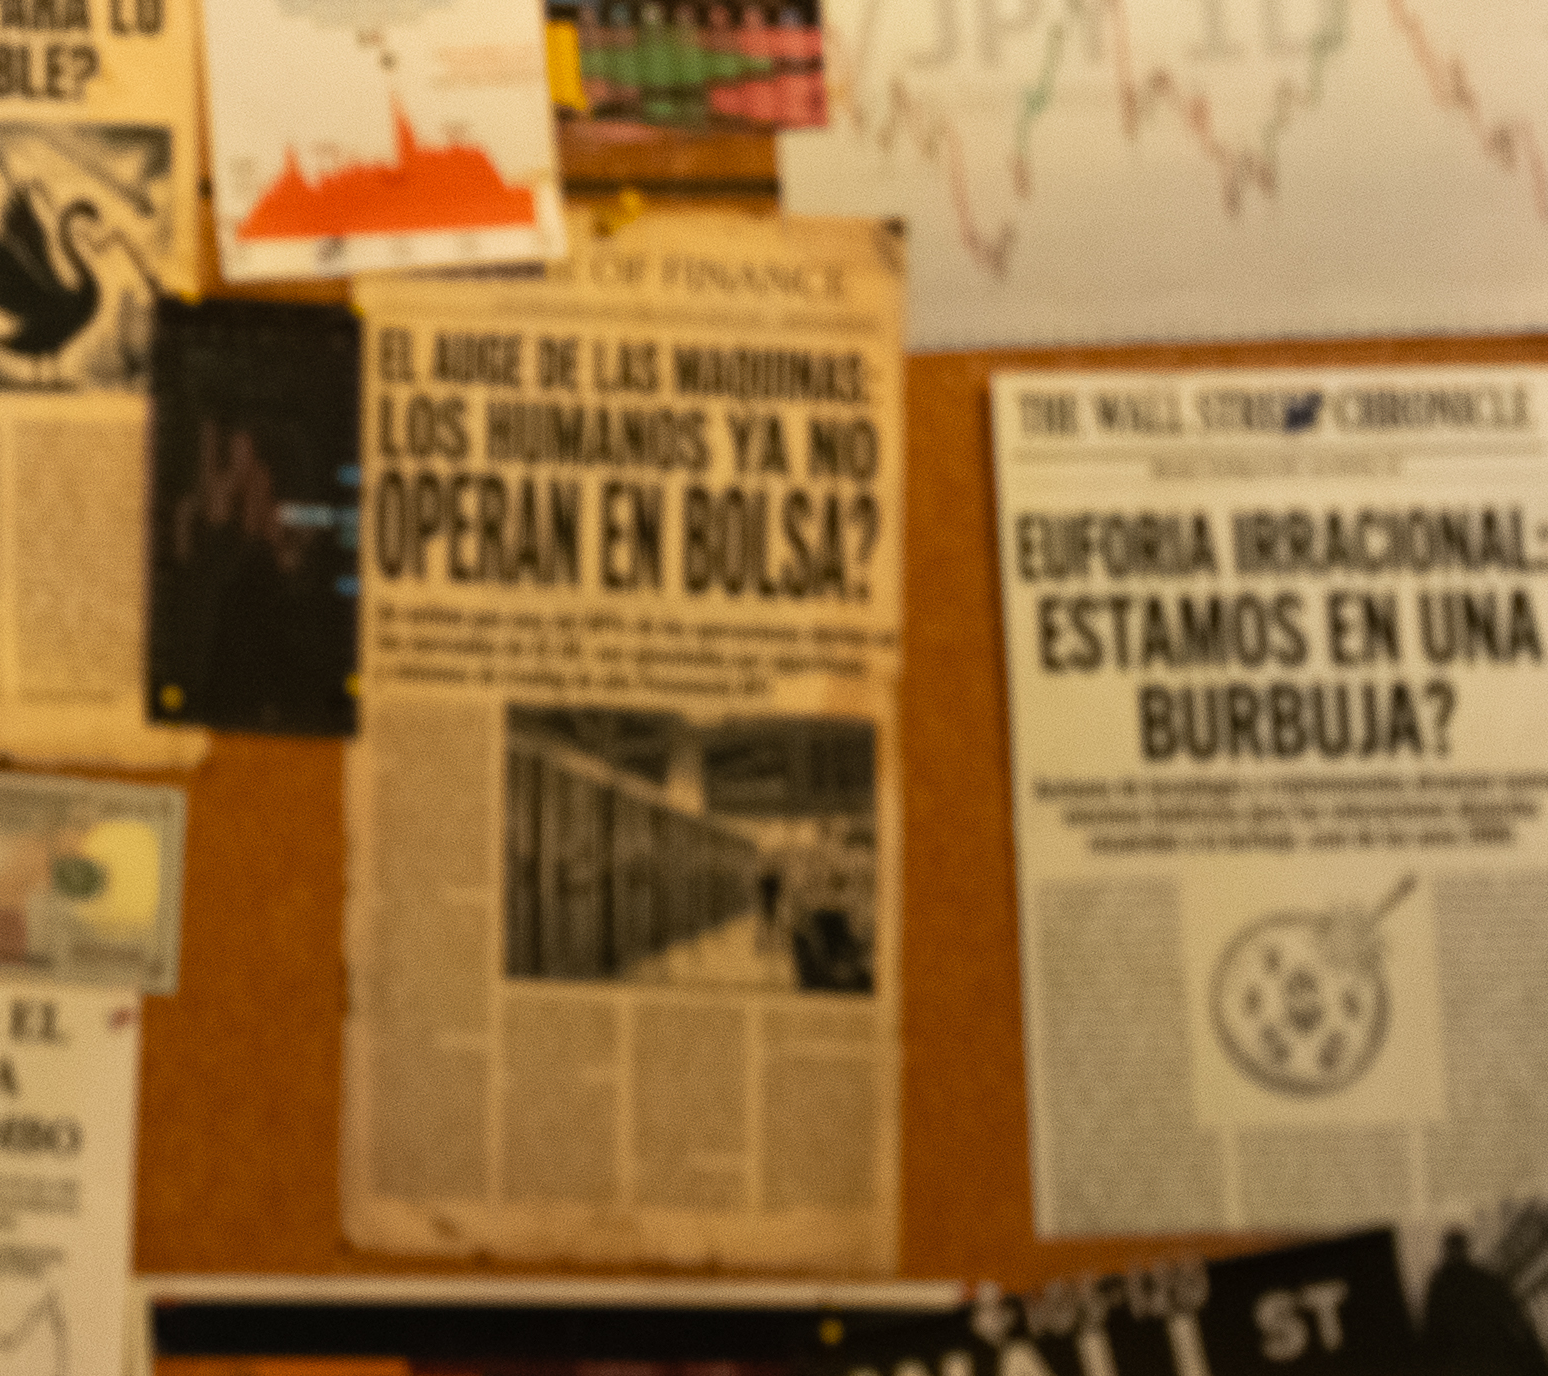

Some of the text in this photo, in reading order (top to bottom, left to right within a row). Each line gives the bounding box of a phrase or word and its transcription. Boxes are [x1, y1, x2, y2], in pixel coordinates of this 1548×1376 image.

[377, 327, 417, 386] EL
[592, 337, 660, 395] LAS
[377, 396, 880, 484] LOS HUMANOS YA NO
[375, 469, 881, 604] OPERAN EN BOLSA?
[1015, 508, 1219, 584] EUFORIA
[1037, 585, 1544, 676] ESTAMOS EN UNA
[1138, 677, 1458, 765] BURBUJA?
[9, 998, 72, 1047] EL
